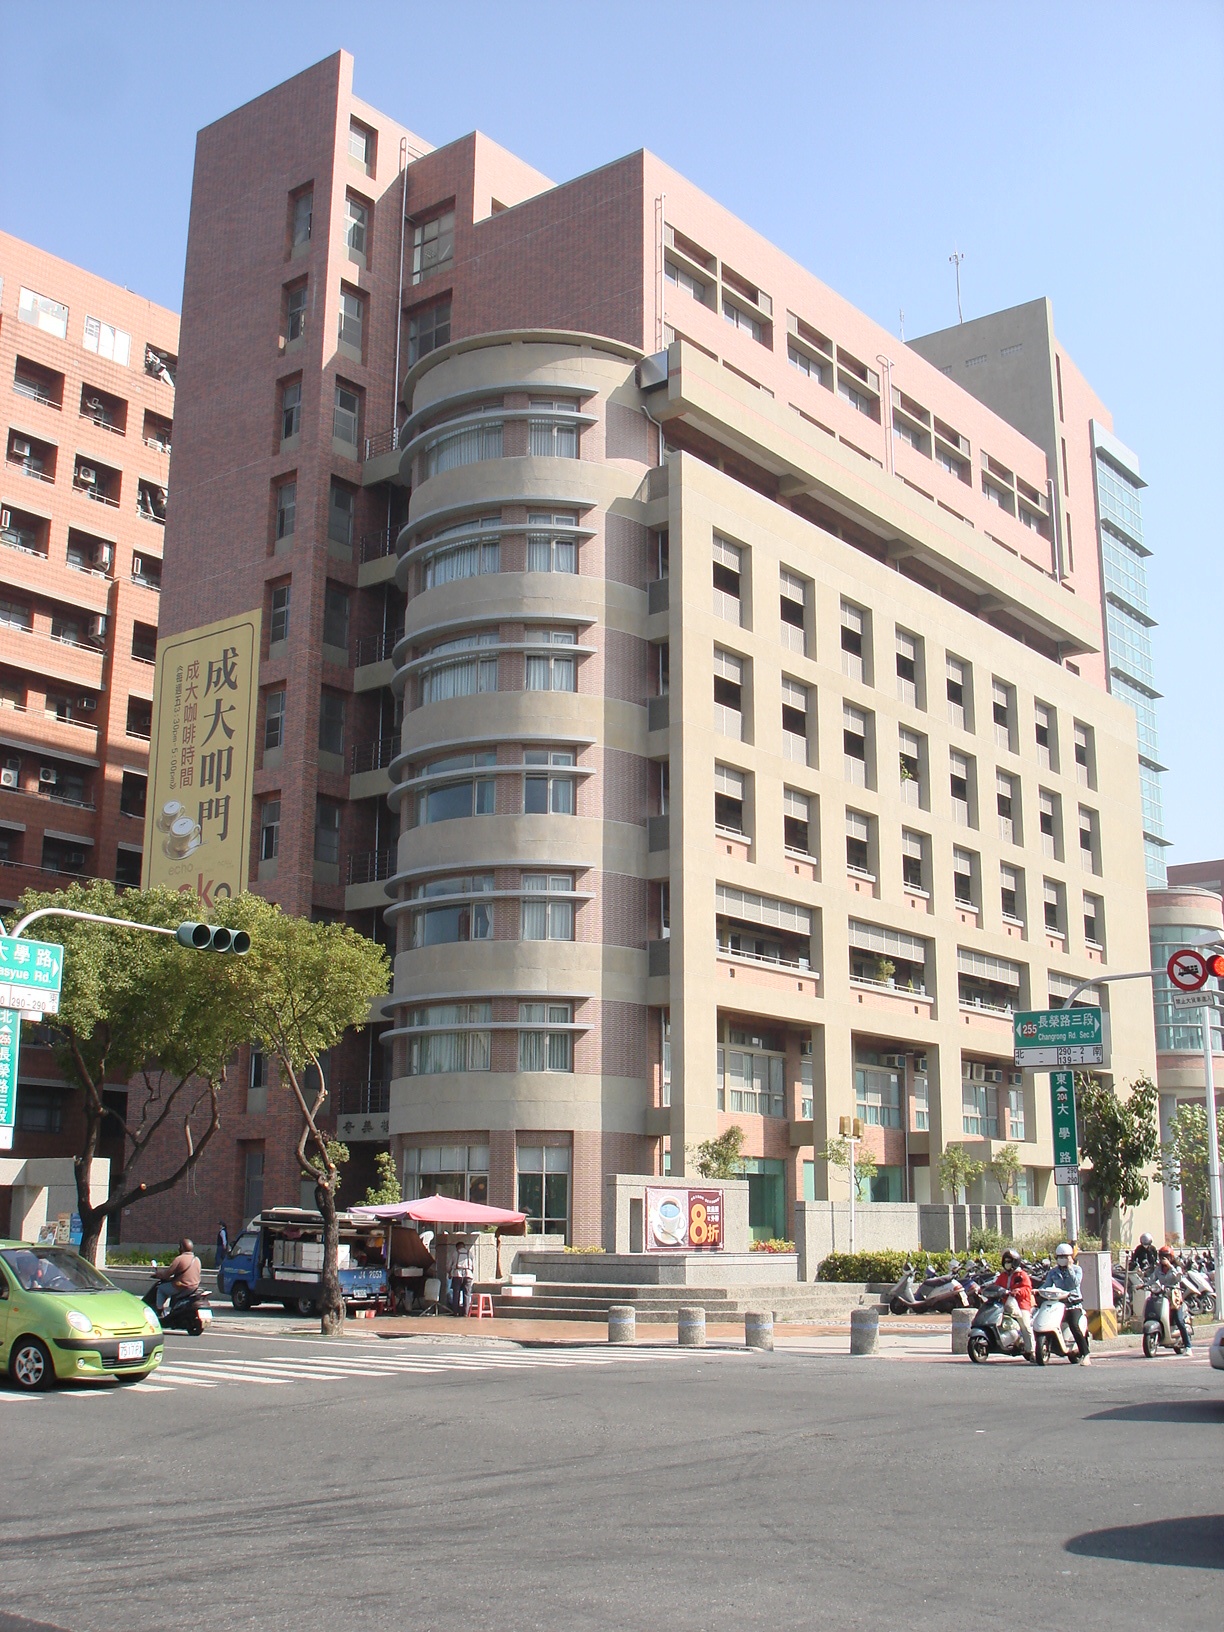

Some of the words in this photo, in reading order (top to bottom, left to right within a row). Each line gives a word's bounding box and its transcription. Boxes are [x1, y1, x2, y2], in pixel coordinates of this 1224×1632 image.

[180, 660, 200, 789] 成大咖啡時間
[199, 646, 239, 844] 成大叩門
[168, 863, 194, 876] echo
[34, 970, 52, 984] Rd.
[1038, 1013, 1094, 1028] 長榮路三段
[1022, 1024, 1038, 1035] 255
[1038, 1032, 1067, 1042] Changrong
[1068, 1031, 1077, 1040] Rd.
[1055, 1073, 1067, 1085] 東
[1057, 1103, 1071, 1163] 大學路
